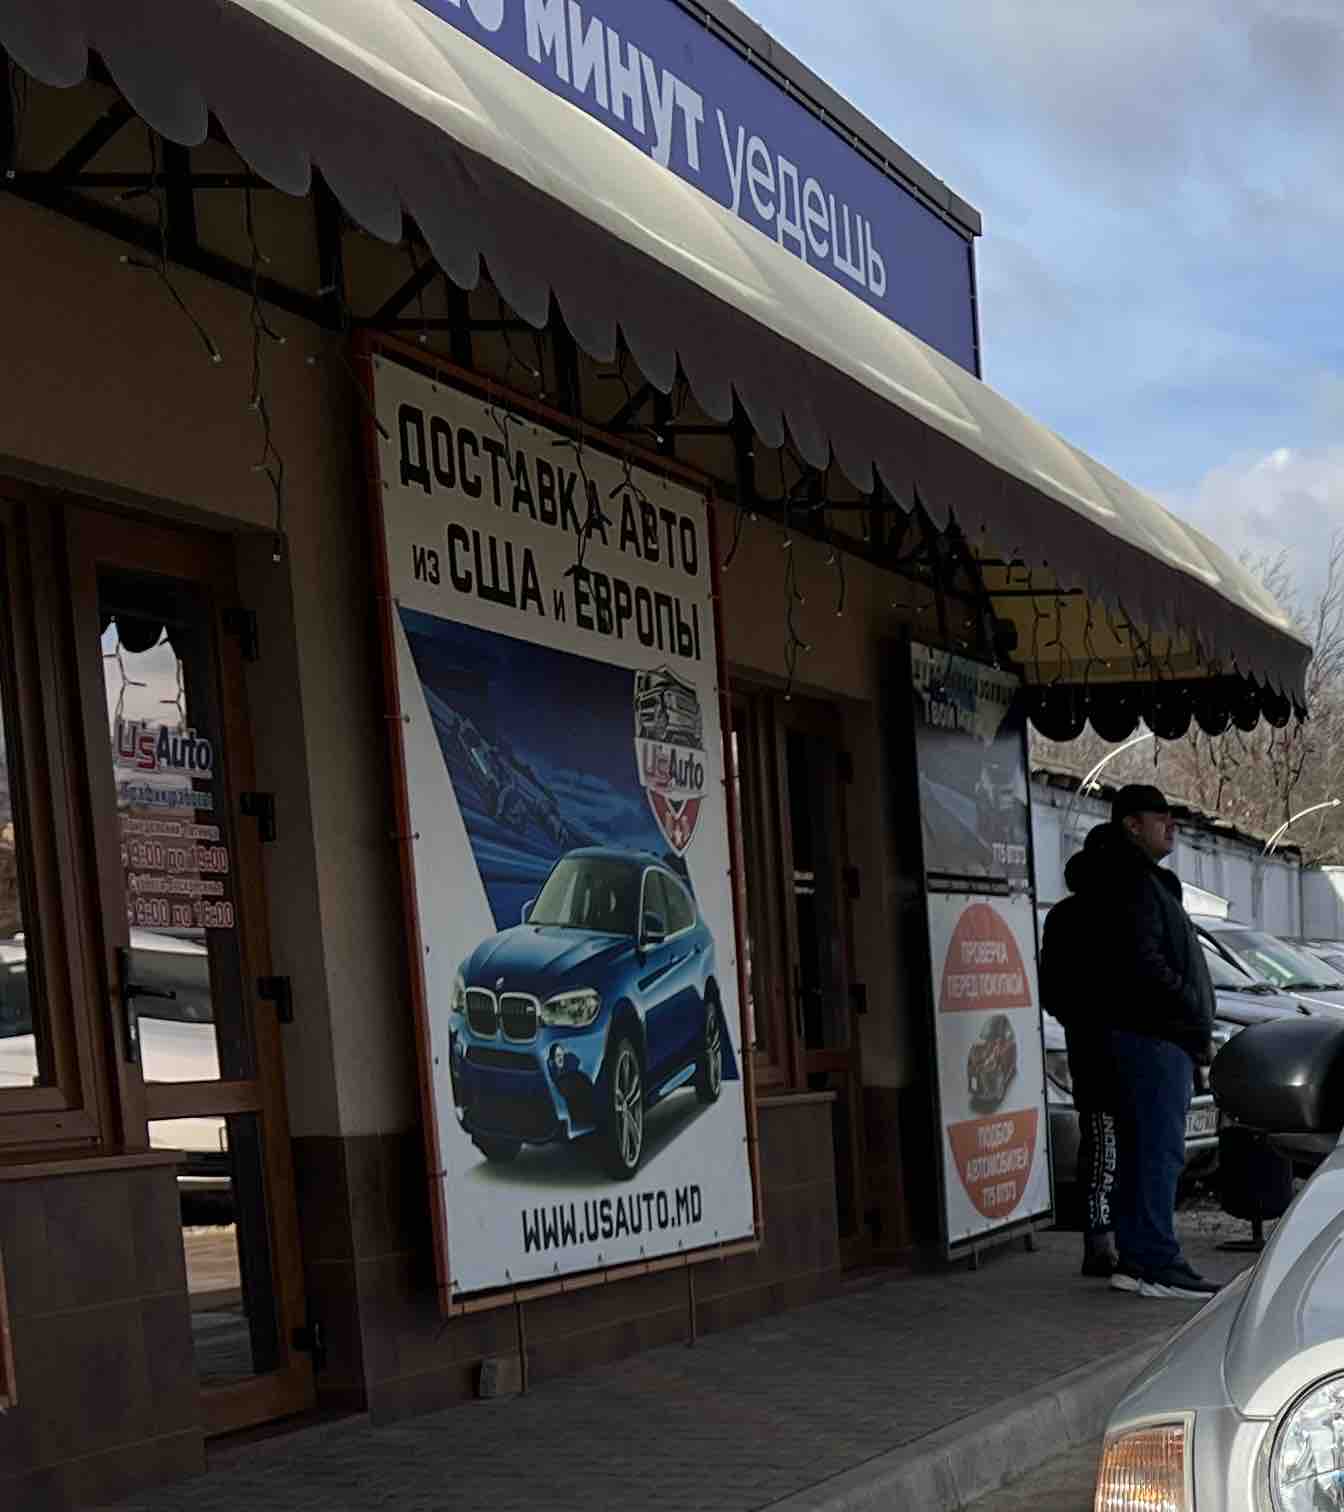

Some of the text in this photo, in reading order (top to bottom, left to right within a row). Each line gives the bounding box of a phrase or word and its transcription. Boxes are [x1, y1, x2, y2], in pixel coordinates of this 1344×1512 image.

[715, 108, 888, 298] уедешь
[398, 403, 699, 578] ДОСТАВКА АВТО
[447, 523, 545, 617] США
[573, 567, 701, 661] ЕВРОПЫ
[521, 1186, 703, 1254] WWW.USAUTO.MD
